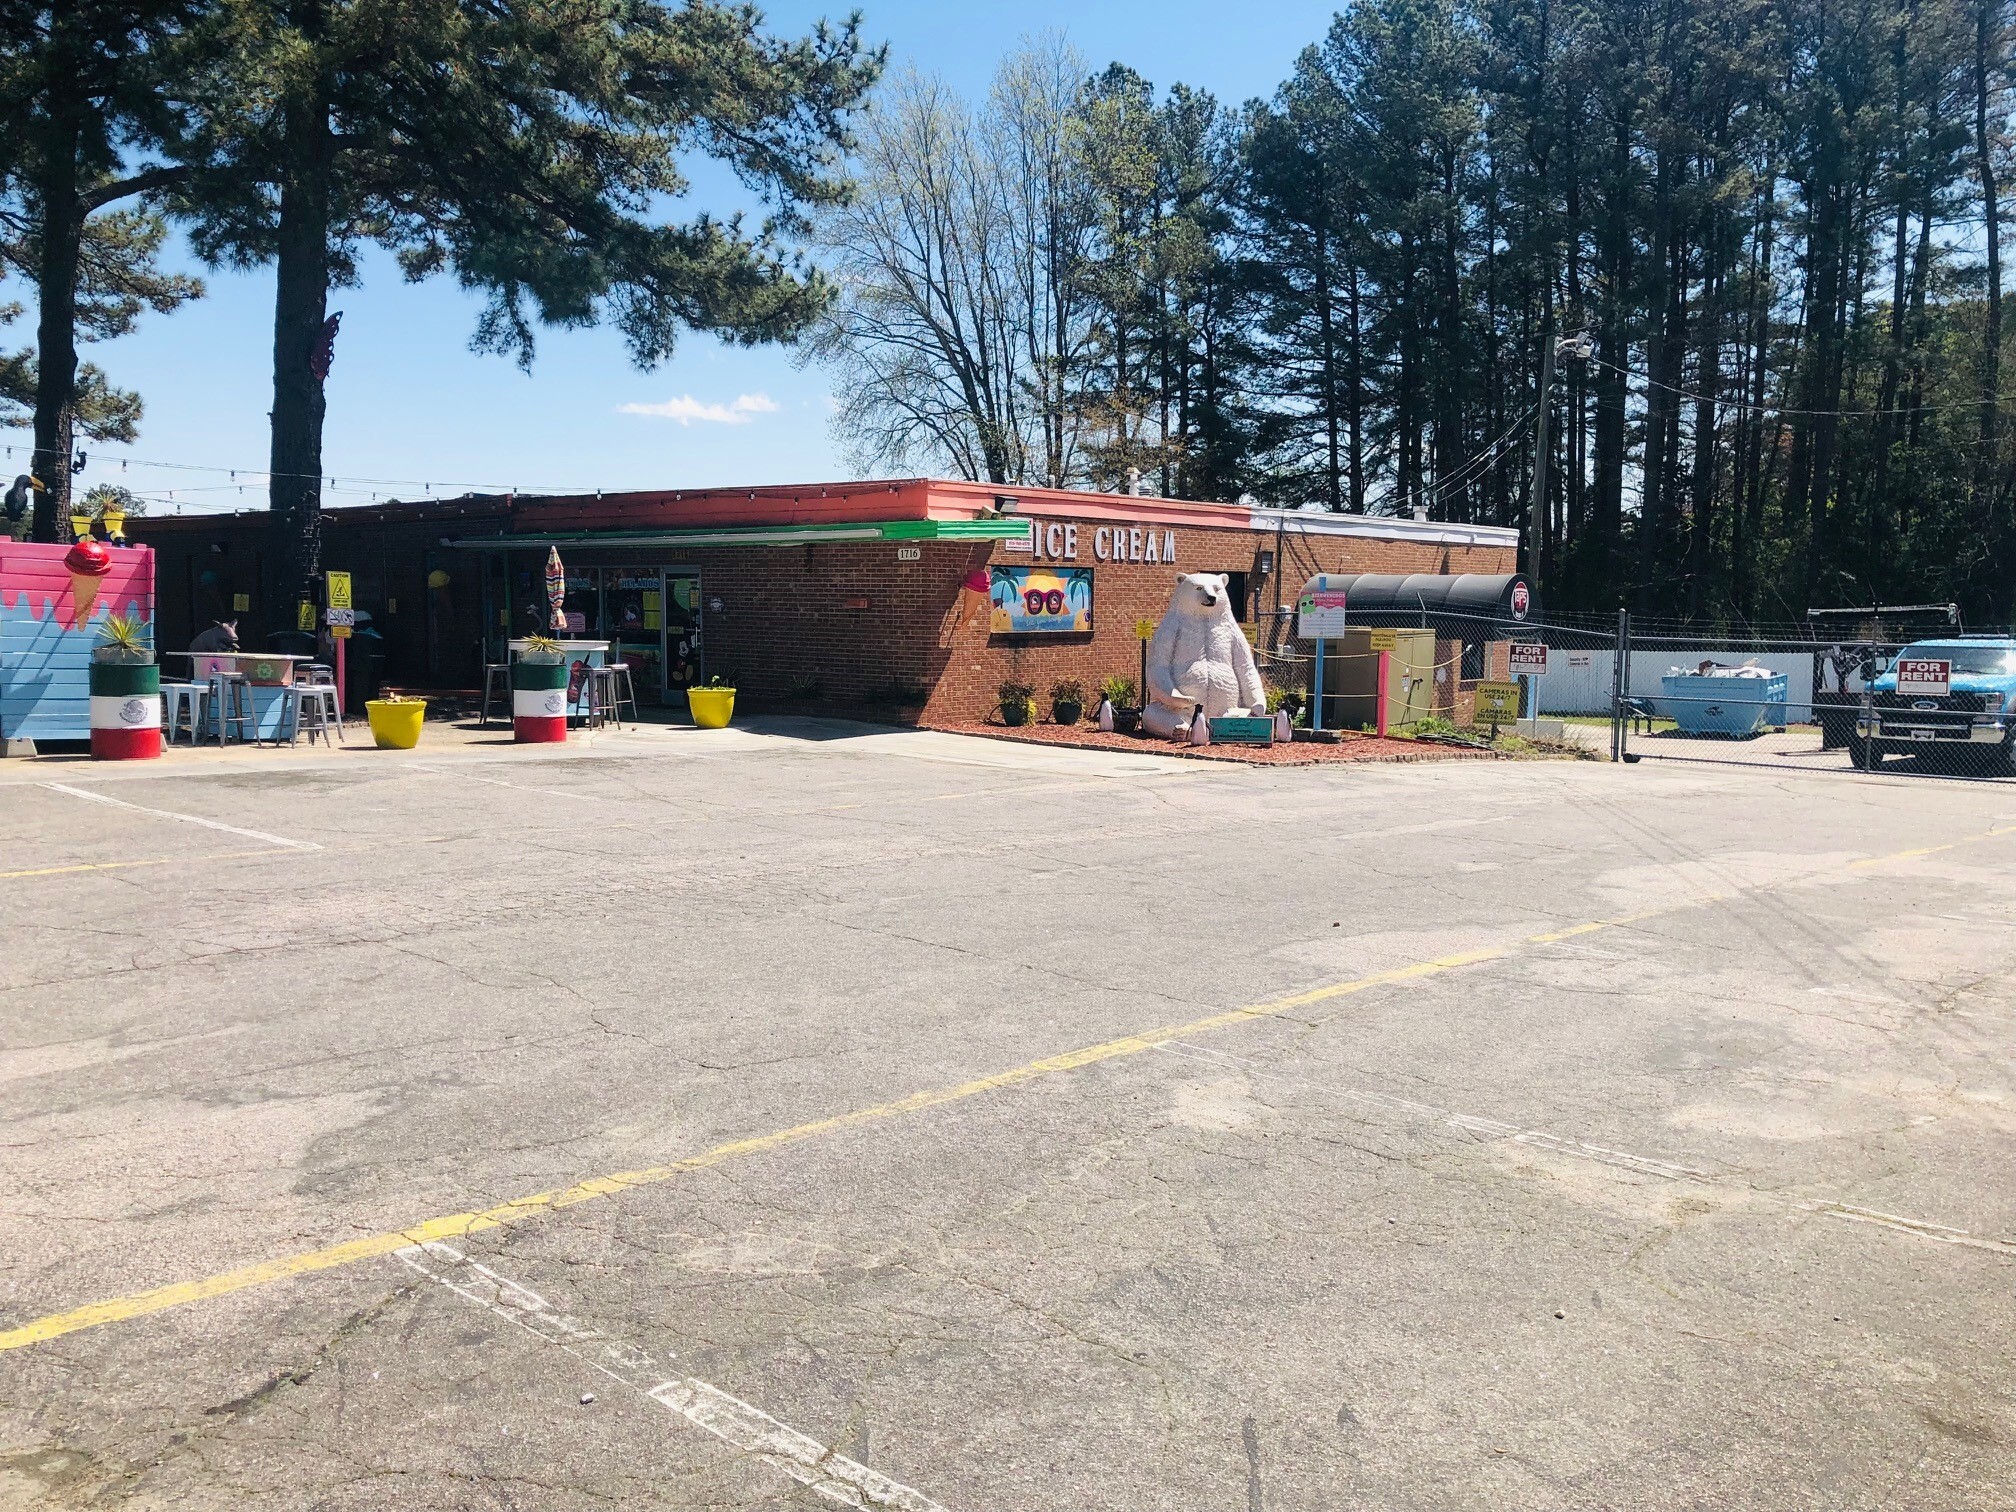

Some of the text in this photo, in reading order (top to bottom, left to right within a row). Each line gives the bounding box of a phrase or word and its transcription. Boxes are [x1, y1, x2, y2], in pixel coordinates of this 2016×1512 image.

[1034, 522, 1175, 561] ICE CREAM
[901, 549, 918, 558] 1716
[1516, 646, 1541, 654] FOR
[1511, 654, 1544, 663] RENT
[1906, 662, 1941, 672] FOR
[1901, 672, 1947, 681] RENT
